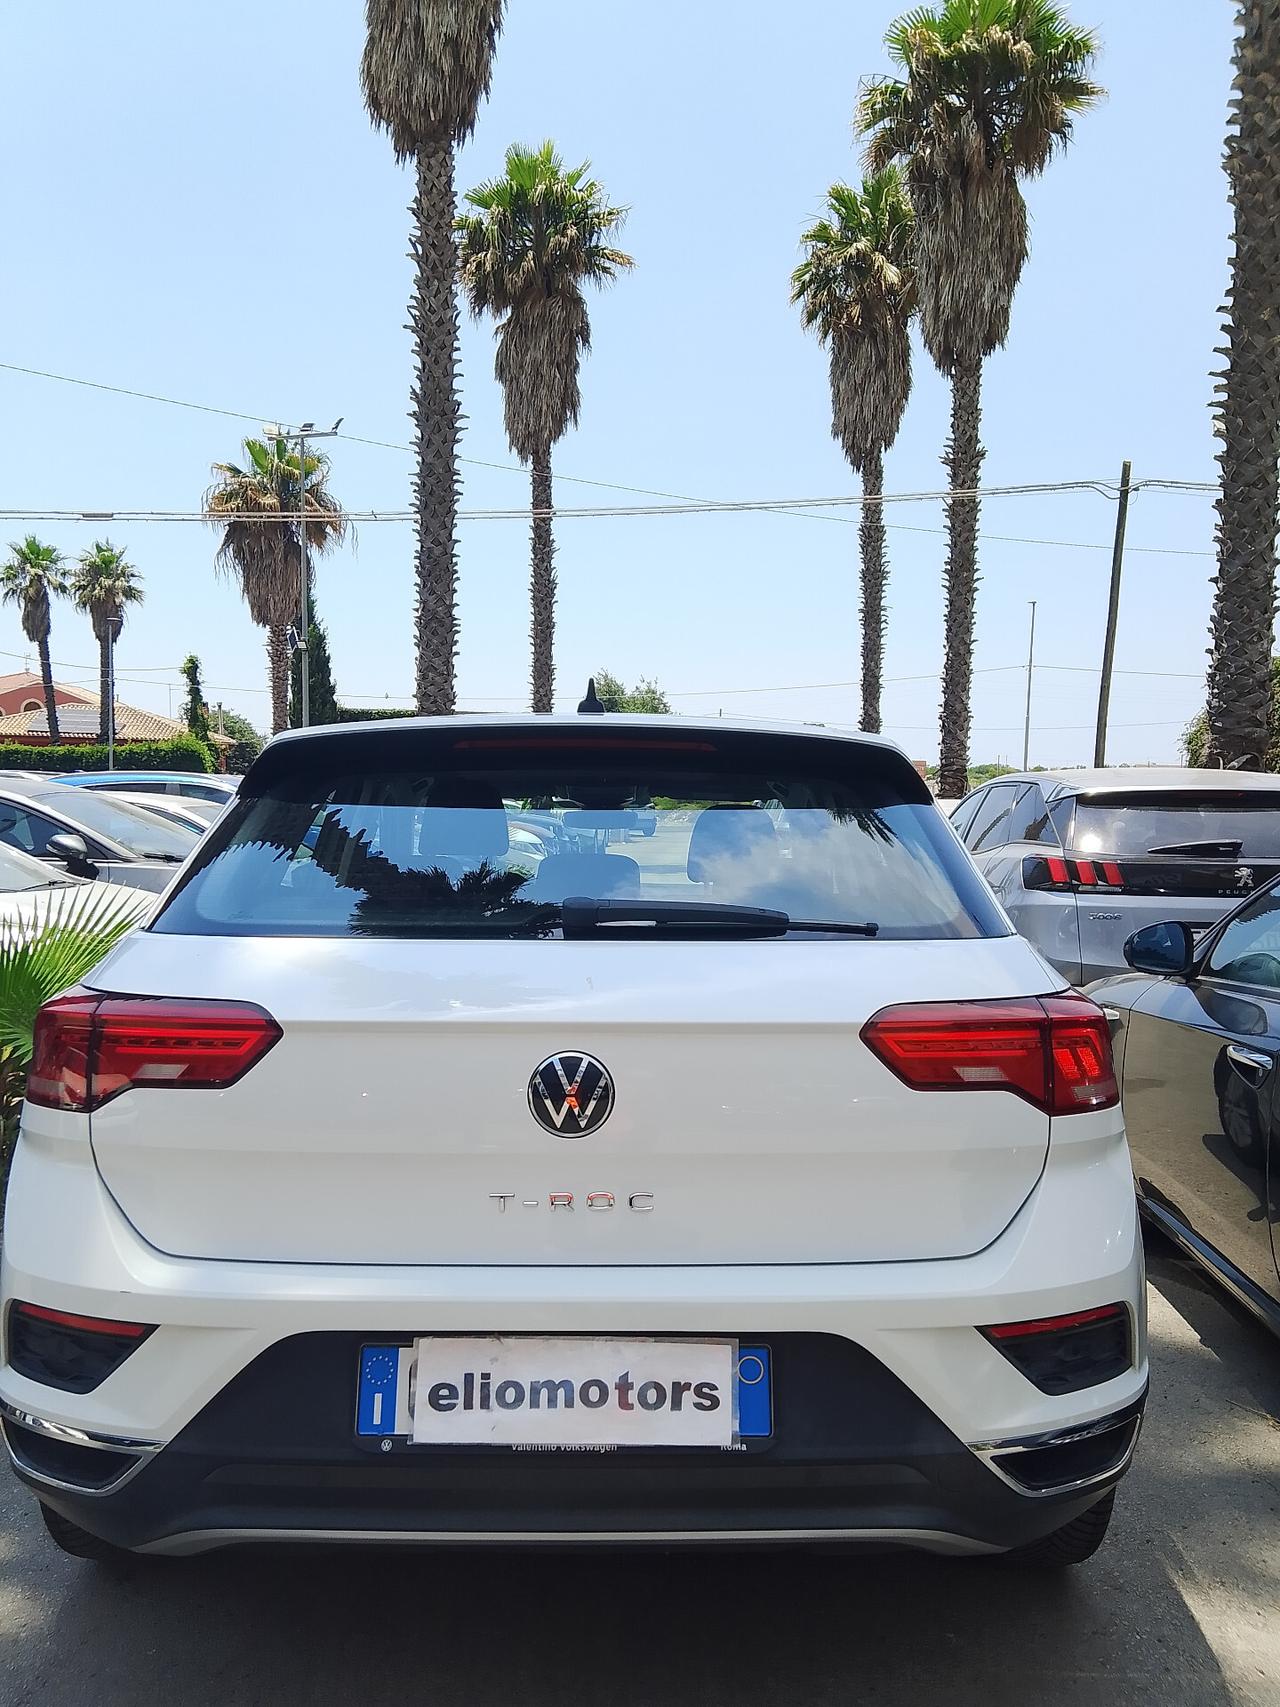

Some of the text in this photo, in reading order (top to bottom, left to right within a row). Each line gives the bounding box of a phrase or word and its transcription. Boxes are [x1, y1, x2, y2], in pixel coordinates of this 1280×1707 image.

[488, 1191, 655, 1213] T-ROC
[427, 1371, 721, 1412] eliomotors
[373, 1393, 383, 1425] I
